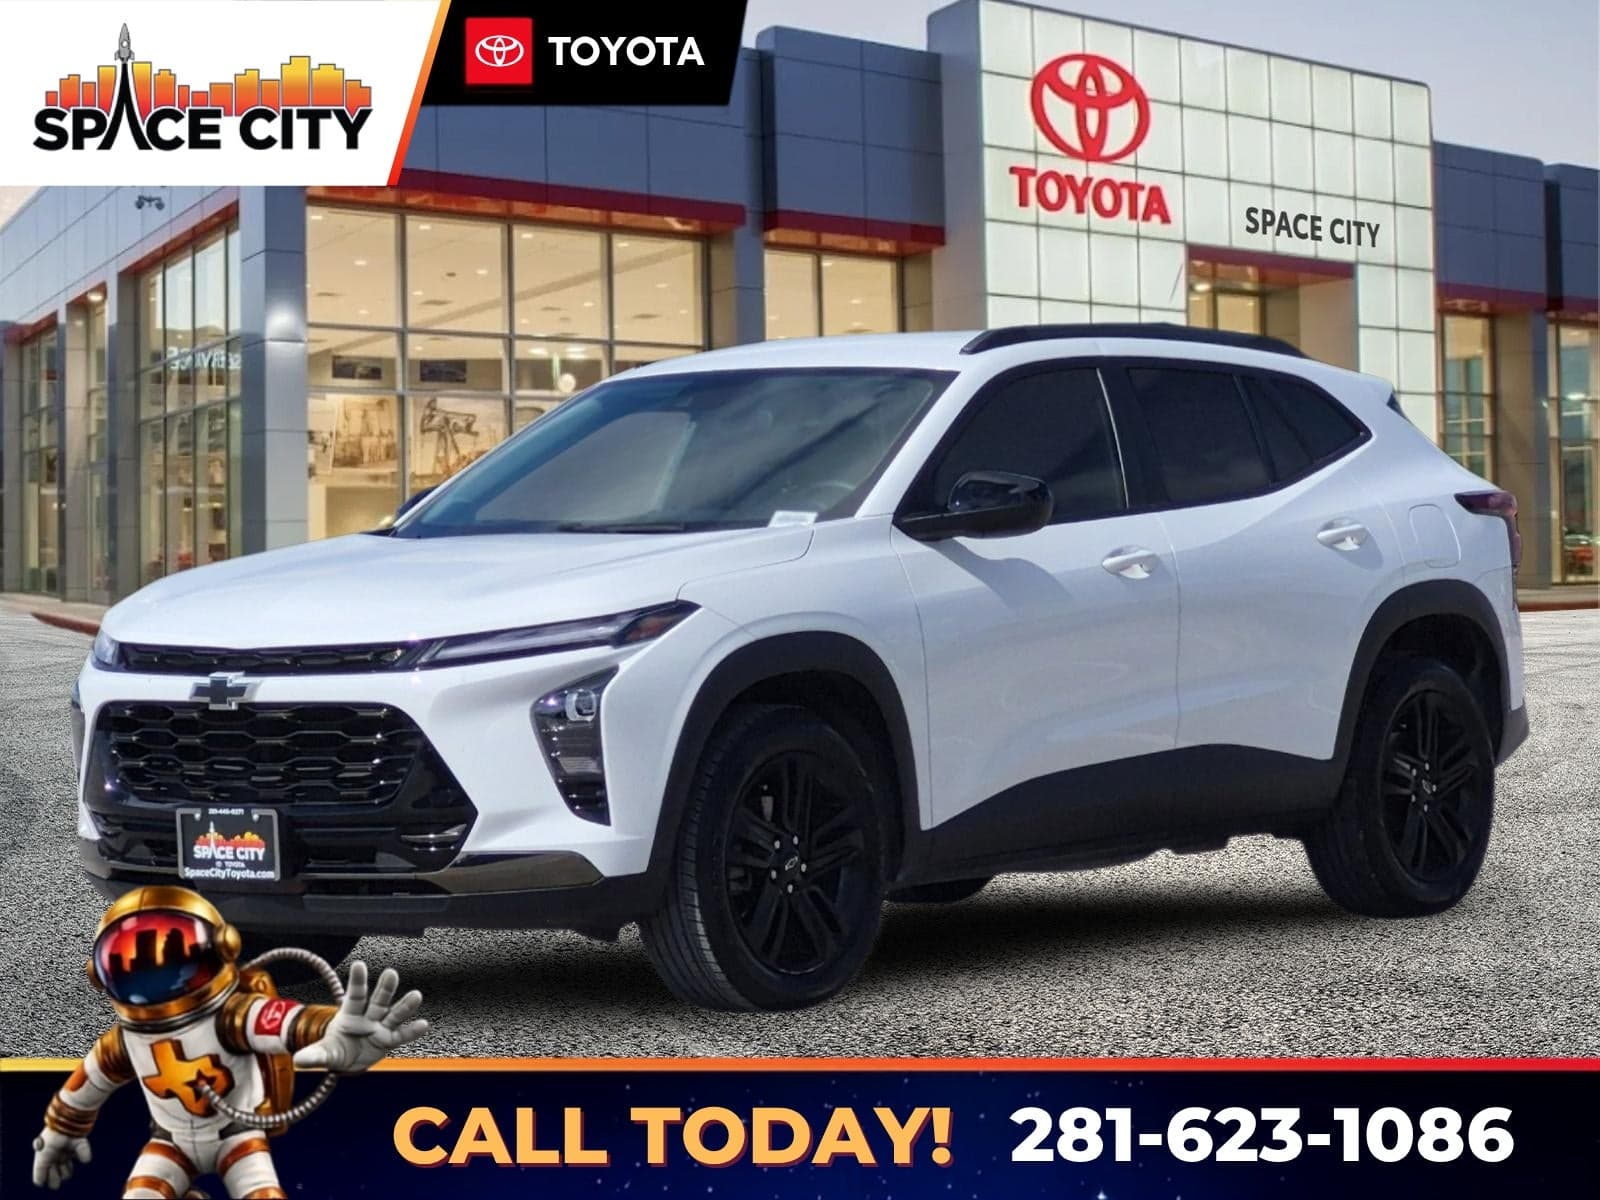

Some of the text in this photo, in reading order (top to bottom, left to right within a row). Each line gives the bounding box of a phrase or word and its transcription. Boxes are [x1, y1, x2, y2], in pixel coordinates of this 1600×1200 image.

[1009, 166, 1171, 225] TOYOTA
[1245, 207, 1381, 248] SPACE CITY
[193, 842, 265, 860] SPACE CITY
[184, 867, 275, 880] SpaceCityToyota.com
